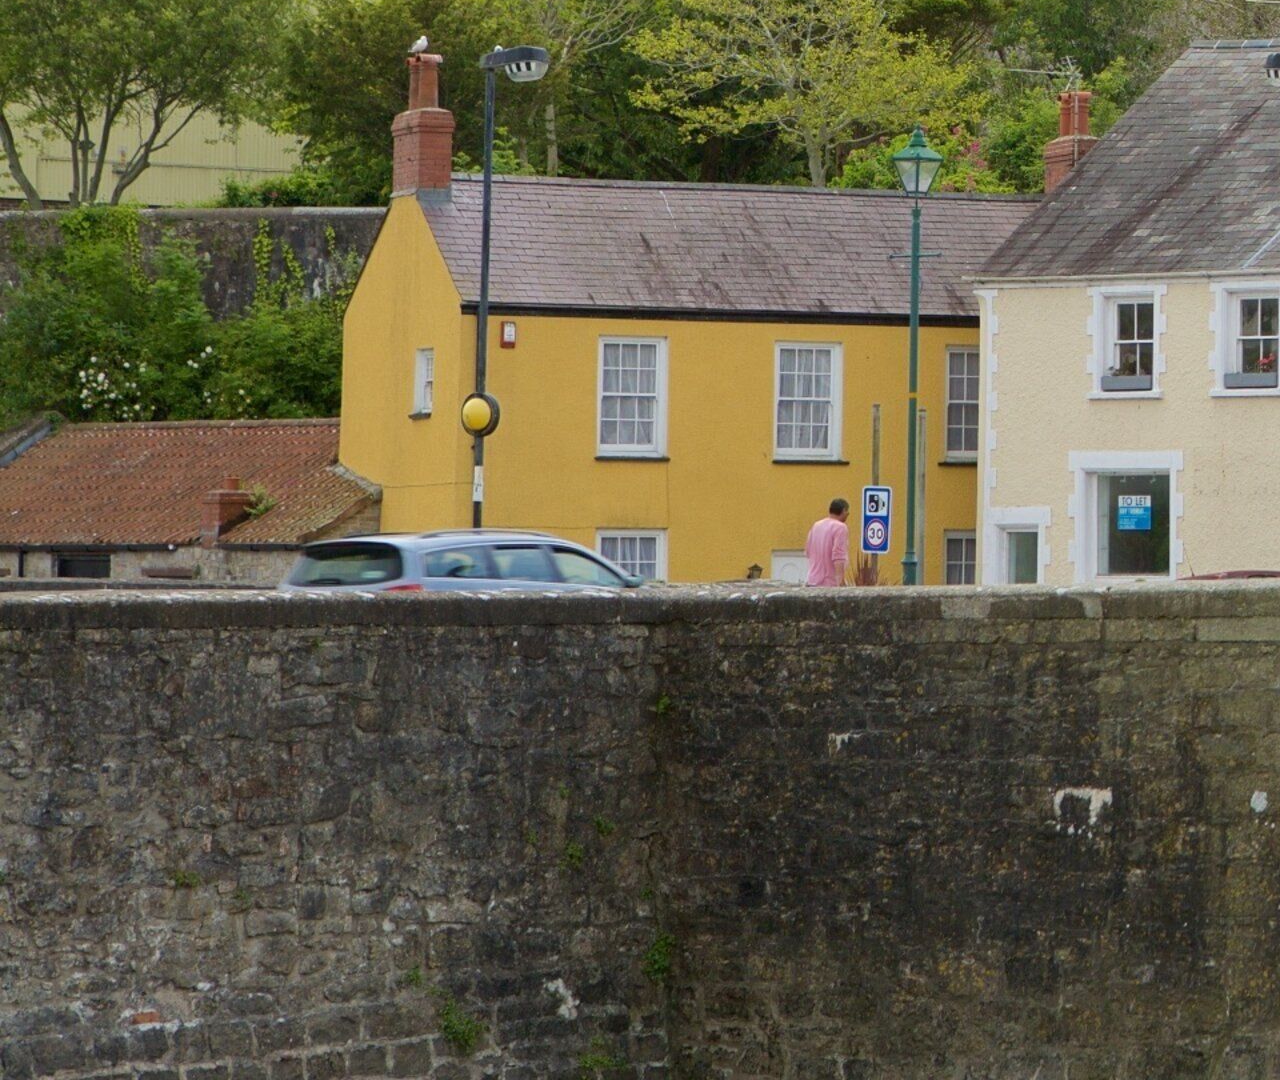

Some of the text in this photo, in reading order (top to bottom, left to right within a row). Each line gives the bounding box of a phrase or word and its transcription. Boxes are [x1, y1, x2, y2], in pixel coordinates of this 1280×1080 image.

[1122, 497, 1146, 506] TO LET
[868, 527, 884, 540] 30
